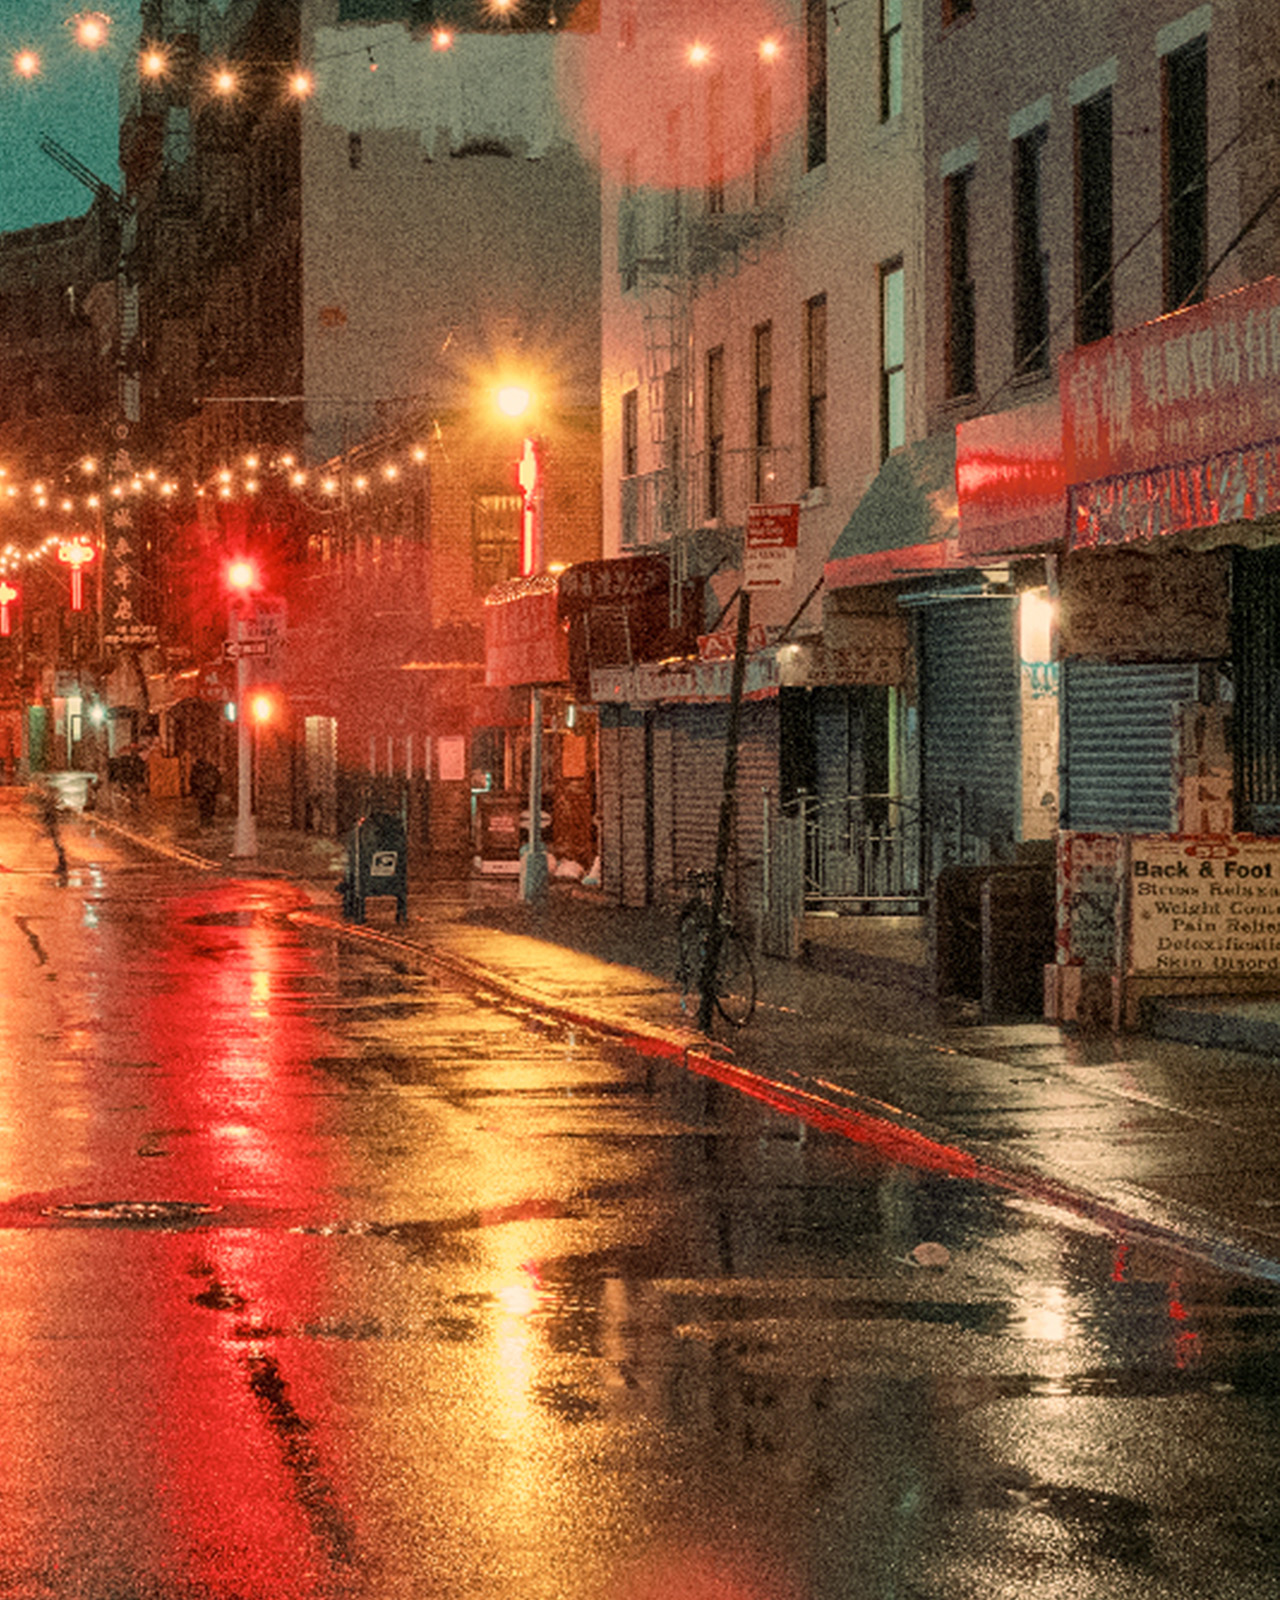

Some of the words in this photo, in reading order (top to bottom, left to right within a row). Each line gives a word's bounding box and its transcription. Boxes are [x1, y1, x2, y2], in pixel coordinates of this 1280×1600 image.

[1134, 860, 1190, 878] Back
[1199, 860, 1215, 878] &
[1224, 861, 1273, 878] Foot
[1154, 901, 1221, 916] Weight
[1172, 918, 1217, 932] Pain
[1156, 954, 1203, 969] Skin
